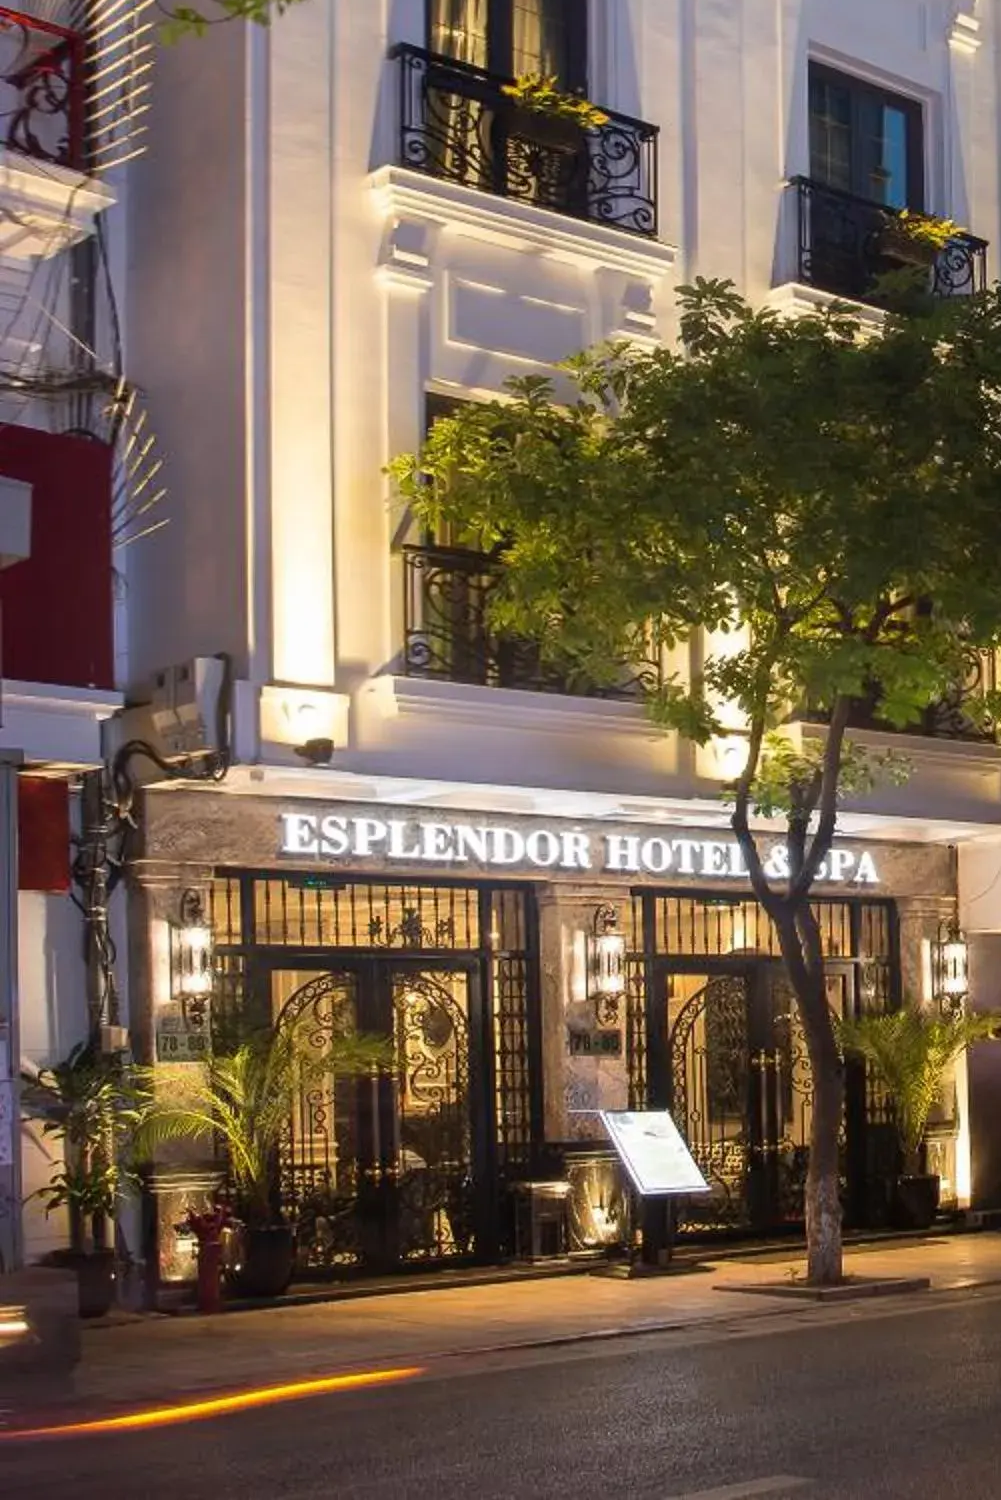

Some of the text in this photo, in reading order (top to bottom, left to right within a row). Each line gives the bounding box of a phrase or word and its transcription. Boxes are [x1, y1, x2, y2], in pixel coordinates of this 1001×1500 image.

[281, 812, 593, 870] ESPLENDOR
[605, 834, 751, 878] HOTEL
[762, 844, 791, 879] &
